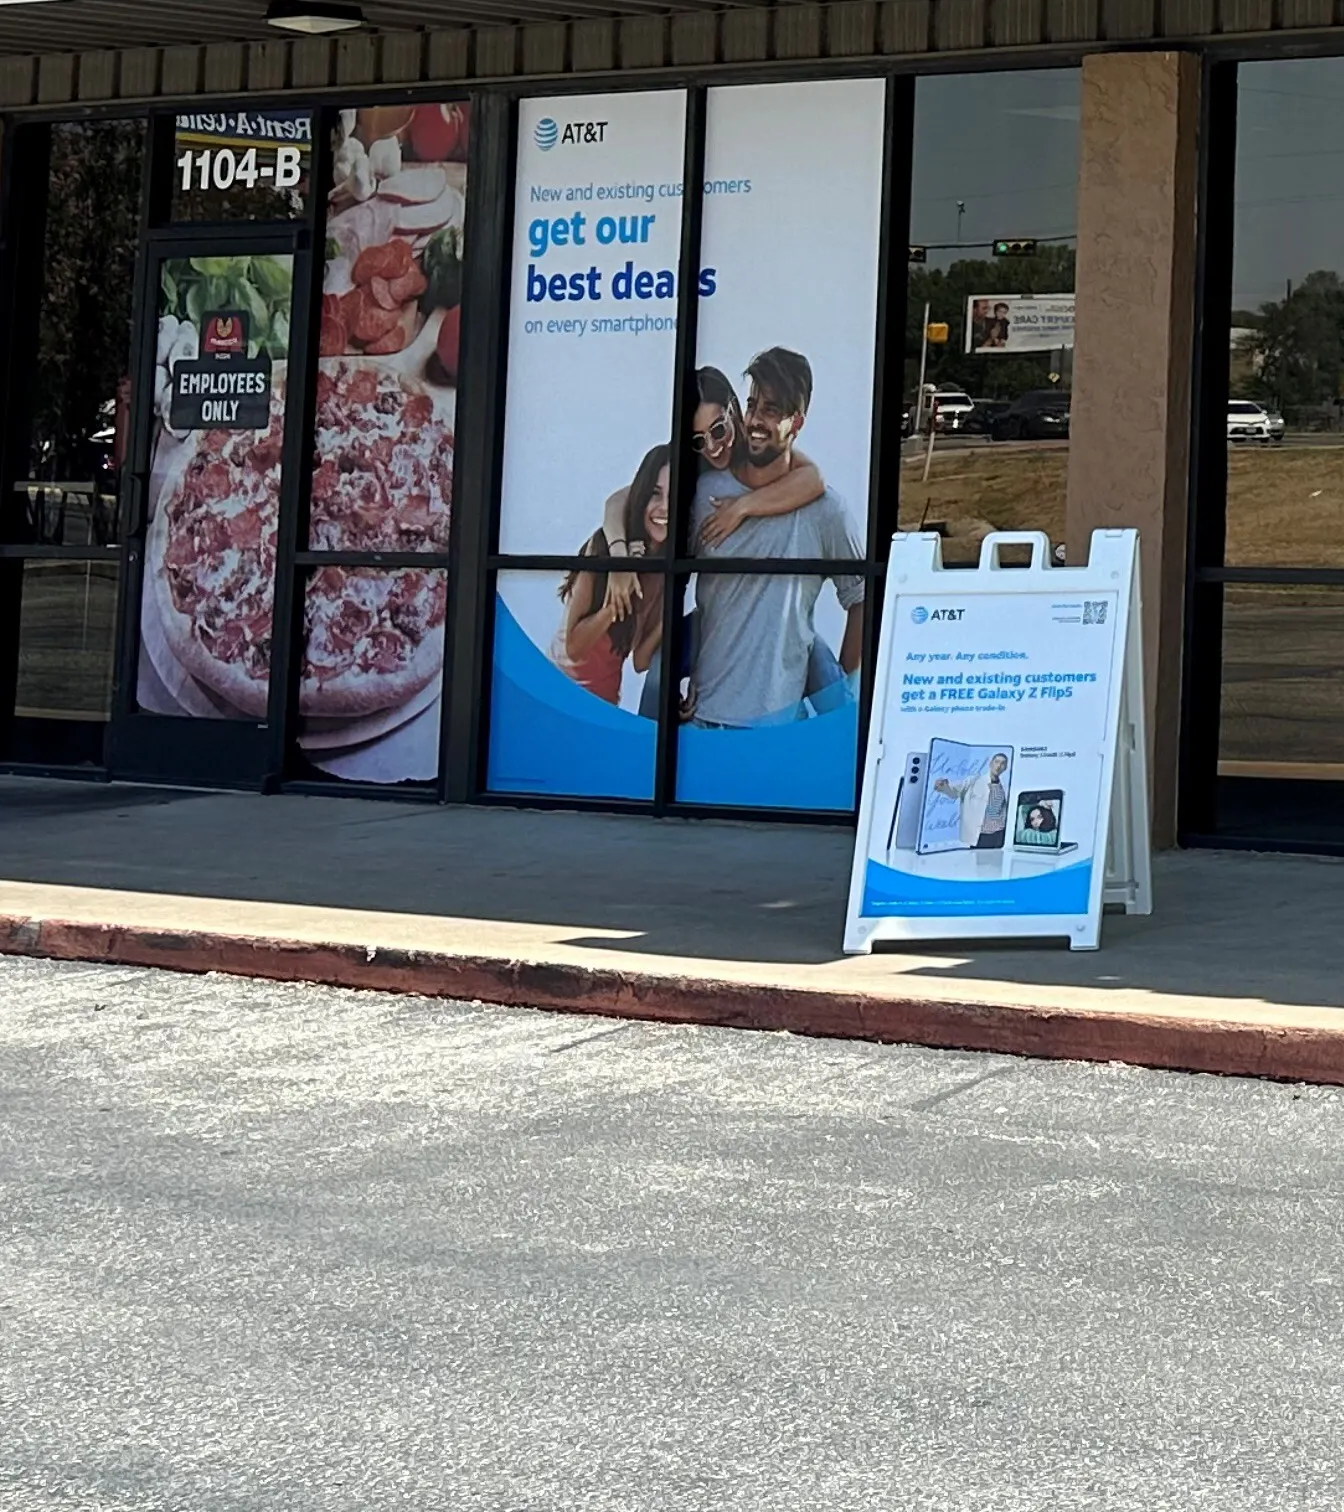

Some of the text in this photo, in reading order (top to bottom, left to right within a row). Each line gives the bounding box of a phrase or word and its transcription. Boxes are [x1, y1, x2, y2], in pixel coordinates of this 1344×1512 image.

[561, 121, 609, 144] AT&T
[177, 147, 301, 191] 1104-B
[530, 179, 752, 203] New and existing cusomers
[528, 211, 656, 258] get our
[526, 261, 717, 302] best deas
[524, 314, 678, 337] on every smartphon
[179, 372, 266, 394] EMPLOYEES
[201, 400, 240, 422] ONLY
[930, 608, 966, 621] AT&T
[905, 650, 1030, 663] Any year. Any condition.
[902, 671, 1097, 687] New and existing customers
[901, 686, 1074, 704] get a FREE Galaxy Z Flip5
